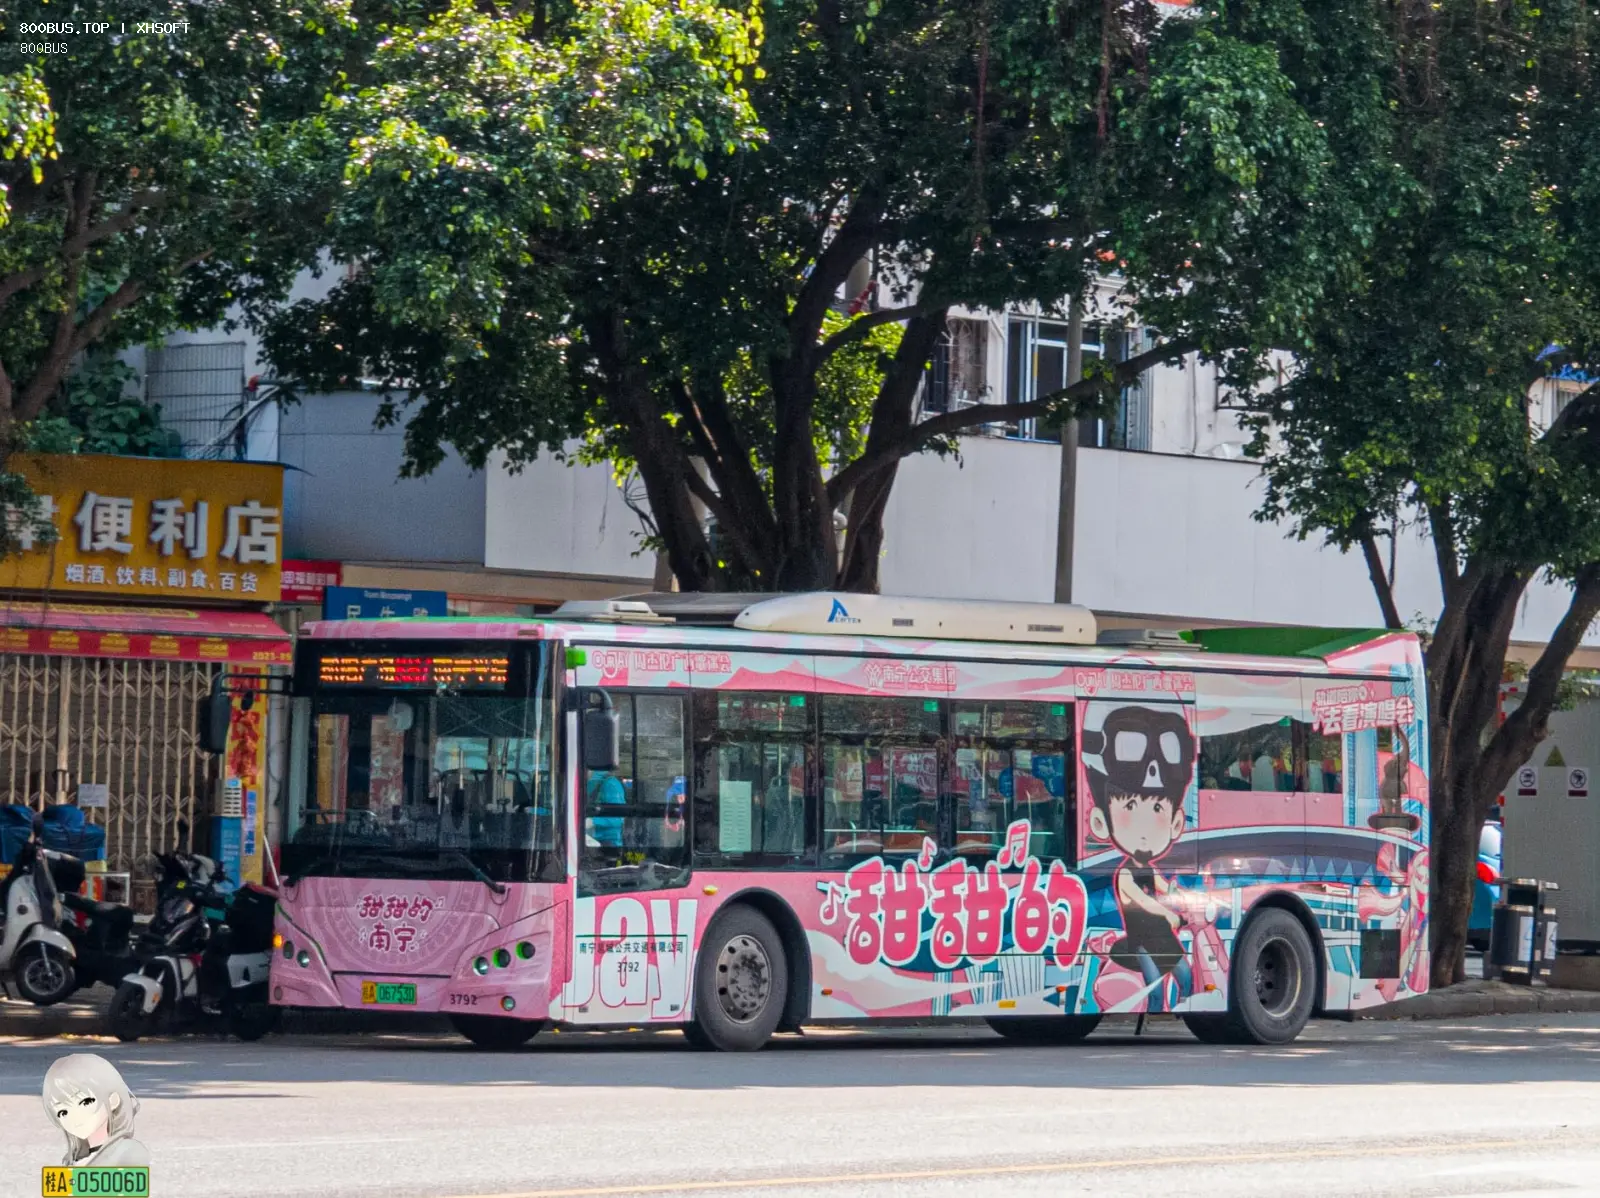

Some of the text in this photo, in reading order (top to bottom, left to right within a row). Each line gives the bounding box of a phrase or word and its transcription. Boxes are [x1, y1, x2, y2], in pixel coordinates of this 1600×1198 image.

[65, 563, 259, 592] 烟酒、饮料、副食、百货
[358, 894, 434, 922] 甜甜的
[846, 857, 1088, 970] 甜甜的
[368, 922, 417, 952] 南宁
[617, 961, 640, 973] 3792
[449, 993, 478, 1006] 3792
